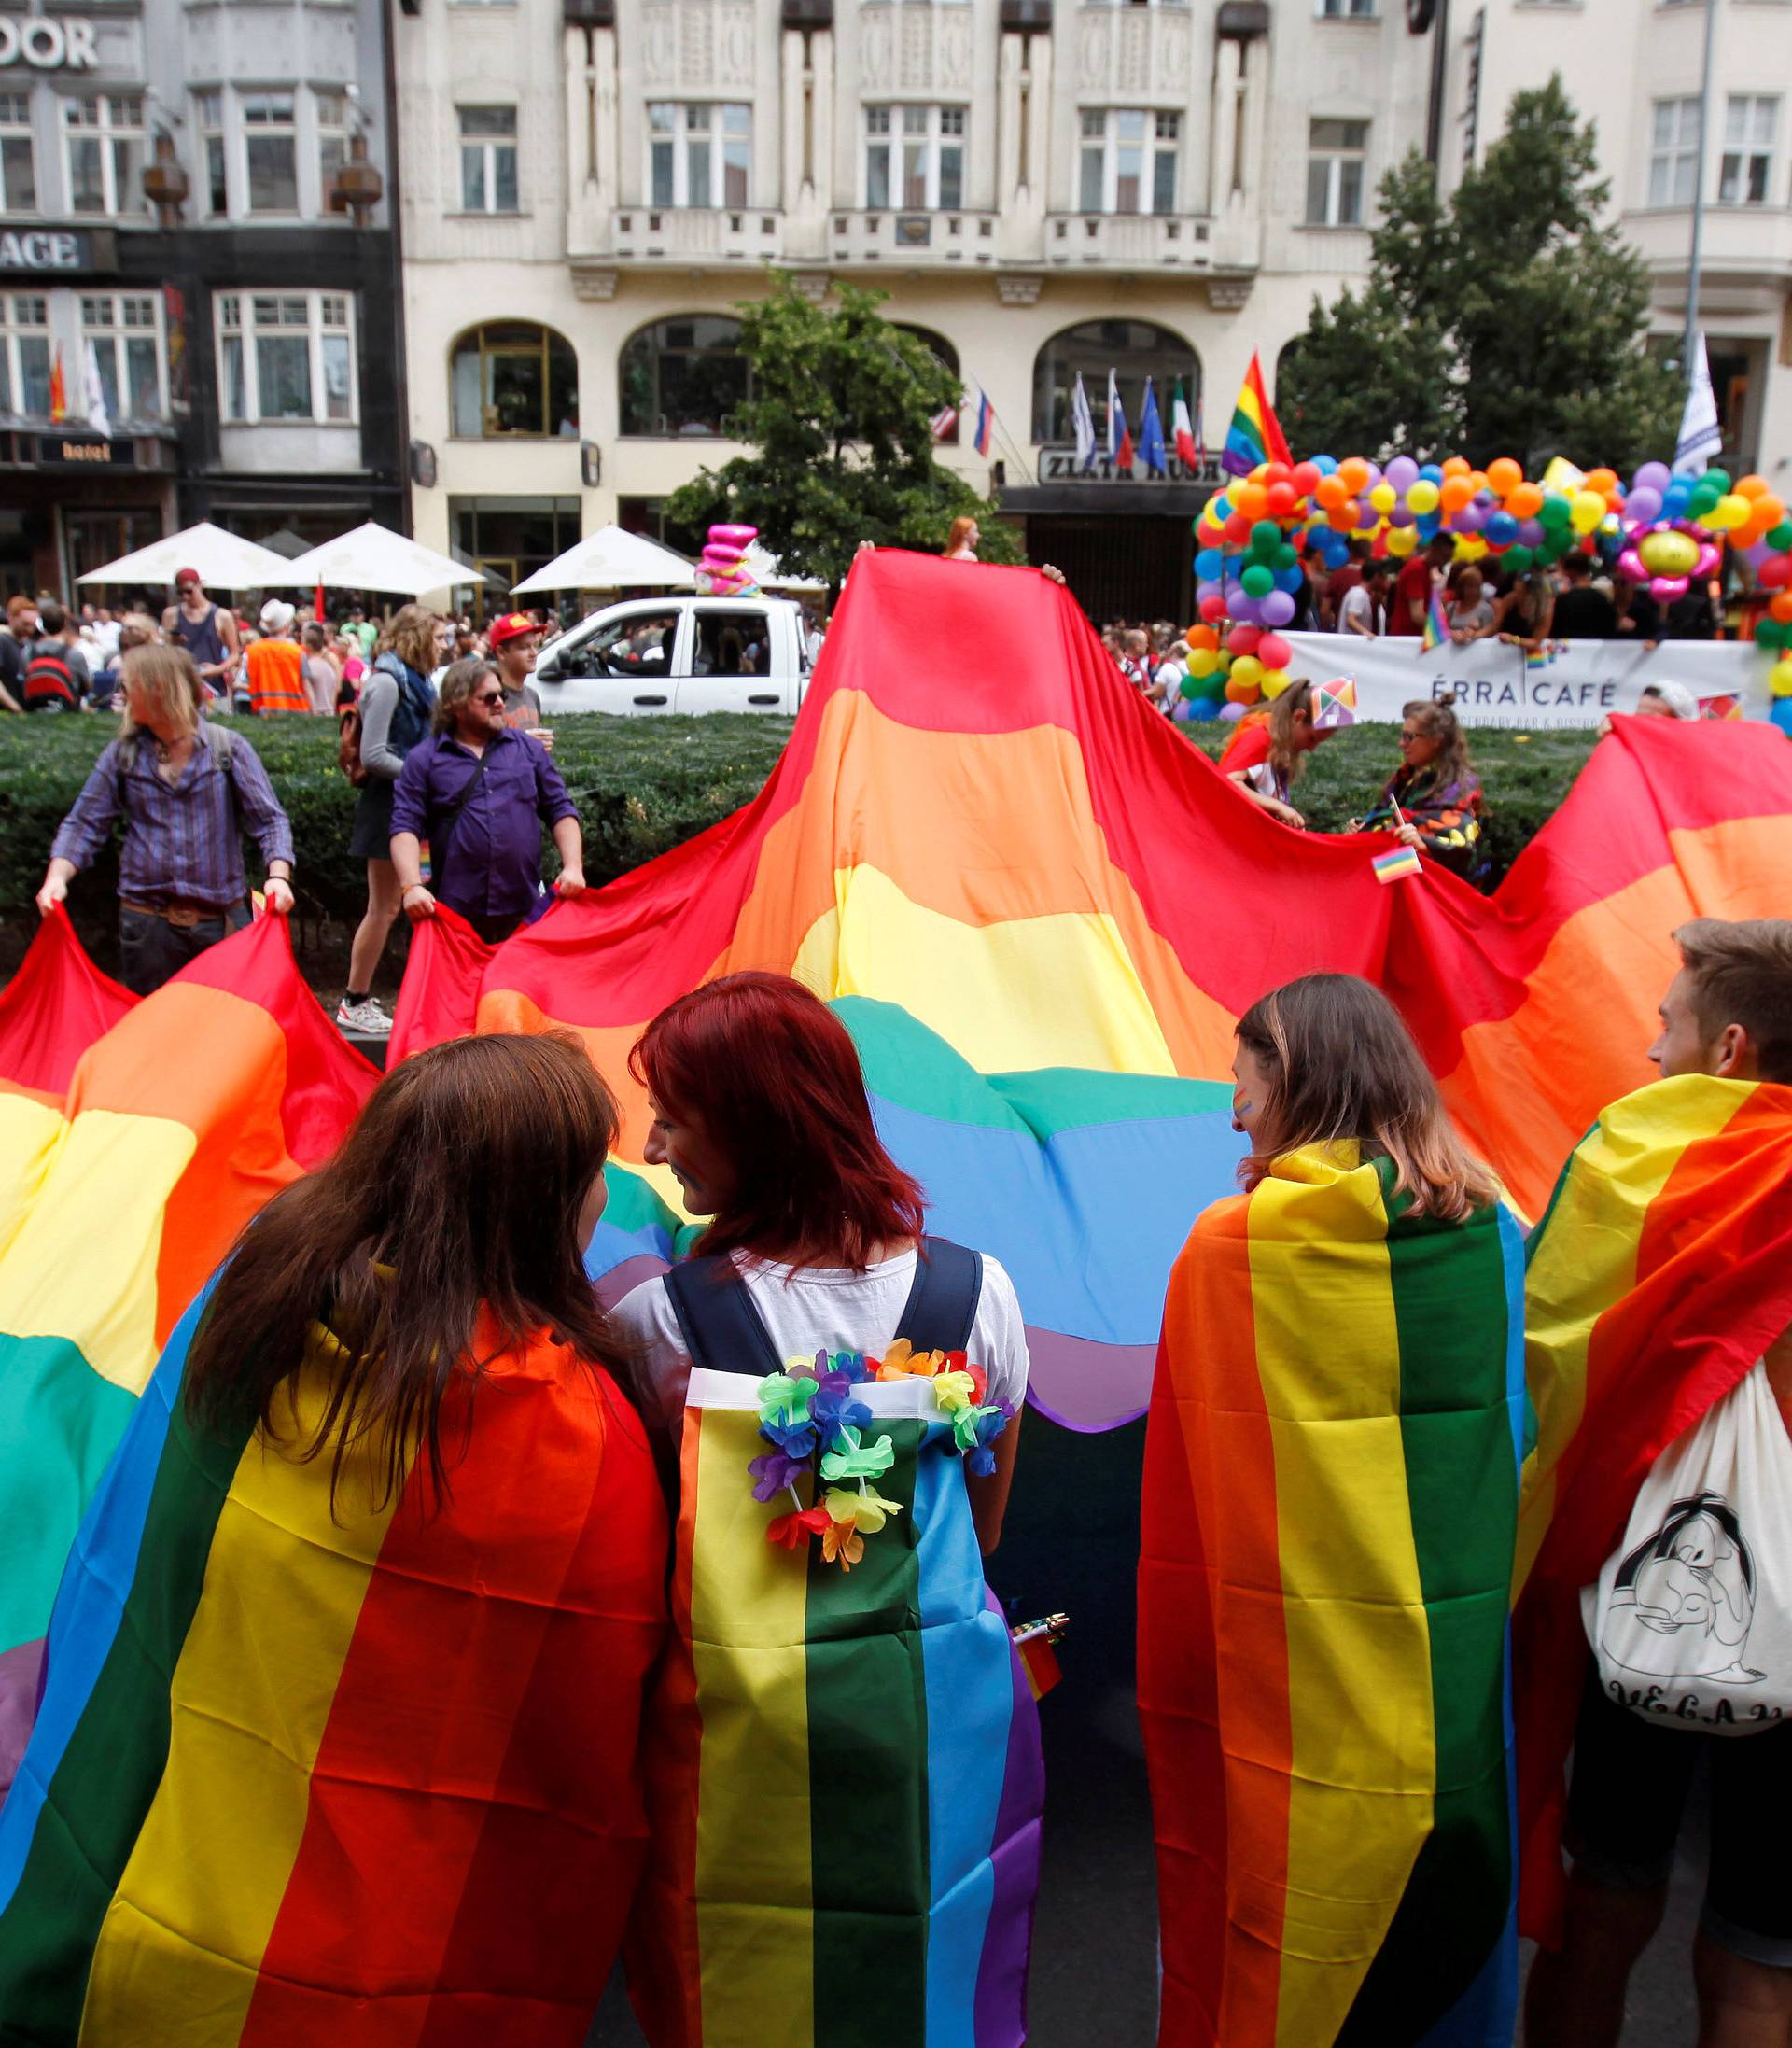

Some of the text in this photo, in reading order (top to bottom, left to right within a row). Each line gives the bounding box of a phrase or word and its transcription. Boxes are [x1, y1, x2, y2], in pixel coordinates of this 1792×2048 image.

[62, 441, 111, 461] hotel
[1432, 673, 1617, 707] ÉRRA CAFÉ
